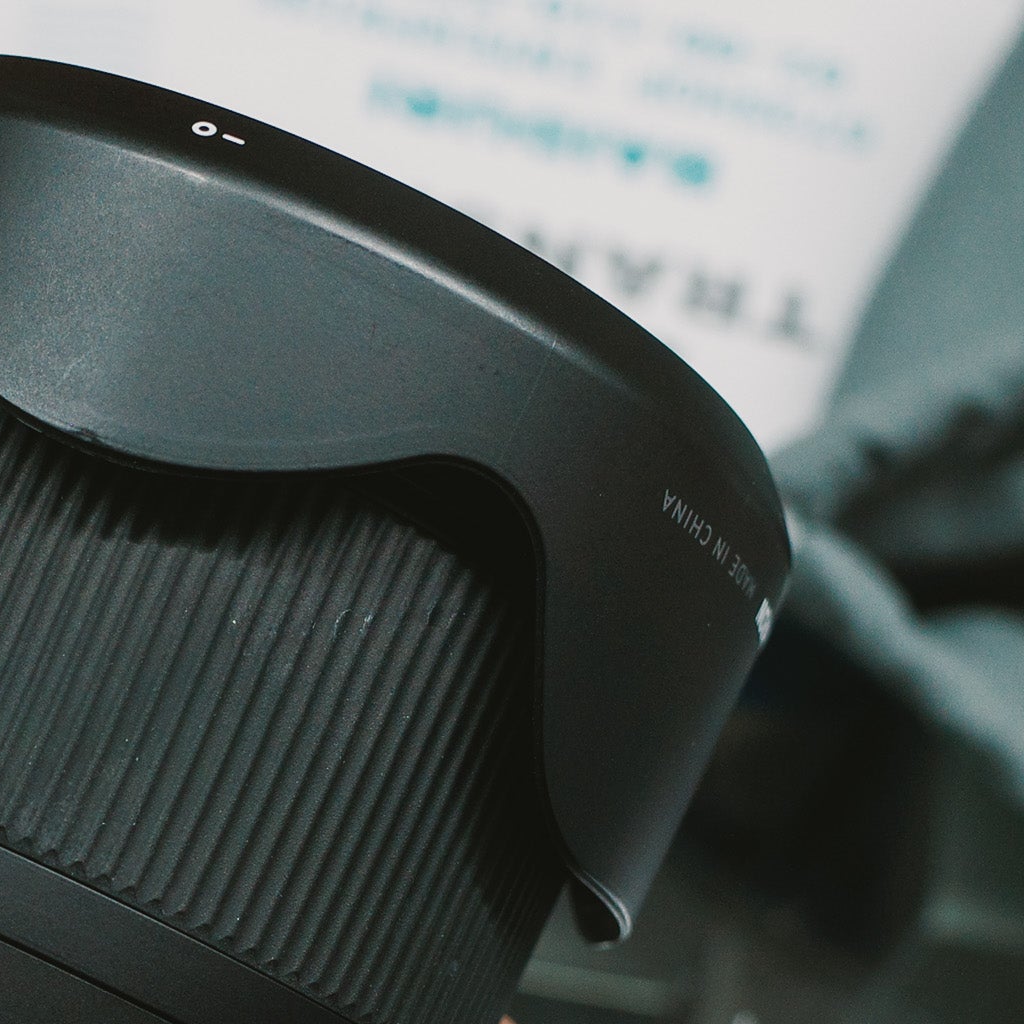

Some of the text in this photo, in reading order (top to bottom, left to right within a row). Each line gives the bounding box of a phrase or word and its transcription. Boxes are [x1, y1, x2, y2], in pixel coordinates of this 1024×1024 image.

[663, 488, 757, 600] MADE IN CHINA
